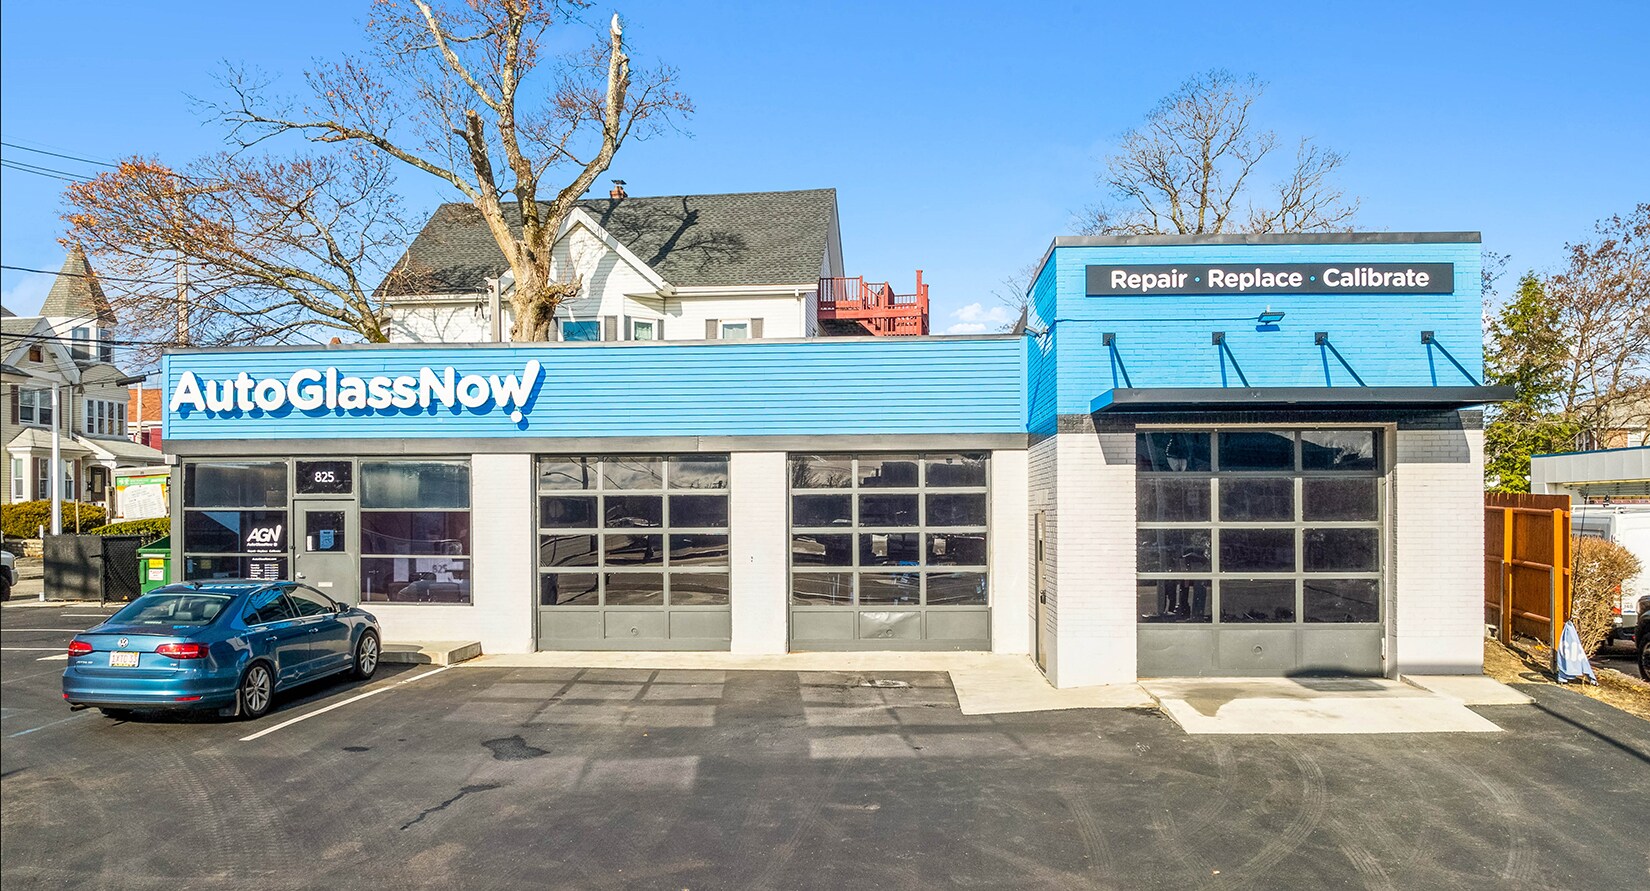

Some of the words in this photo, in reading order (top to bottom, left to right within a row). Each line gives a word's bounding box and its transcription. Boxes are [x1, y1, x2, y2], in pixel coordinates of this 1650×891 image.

[1110, 269, 1188, 292] Repair
[1207, 268, 1303, 292] Replace
[1322, 267, 1430, 288] Calibrate
[169, 359, 541, 424] AutoGlassNow!
[314, 471, 335, 483] 825
